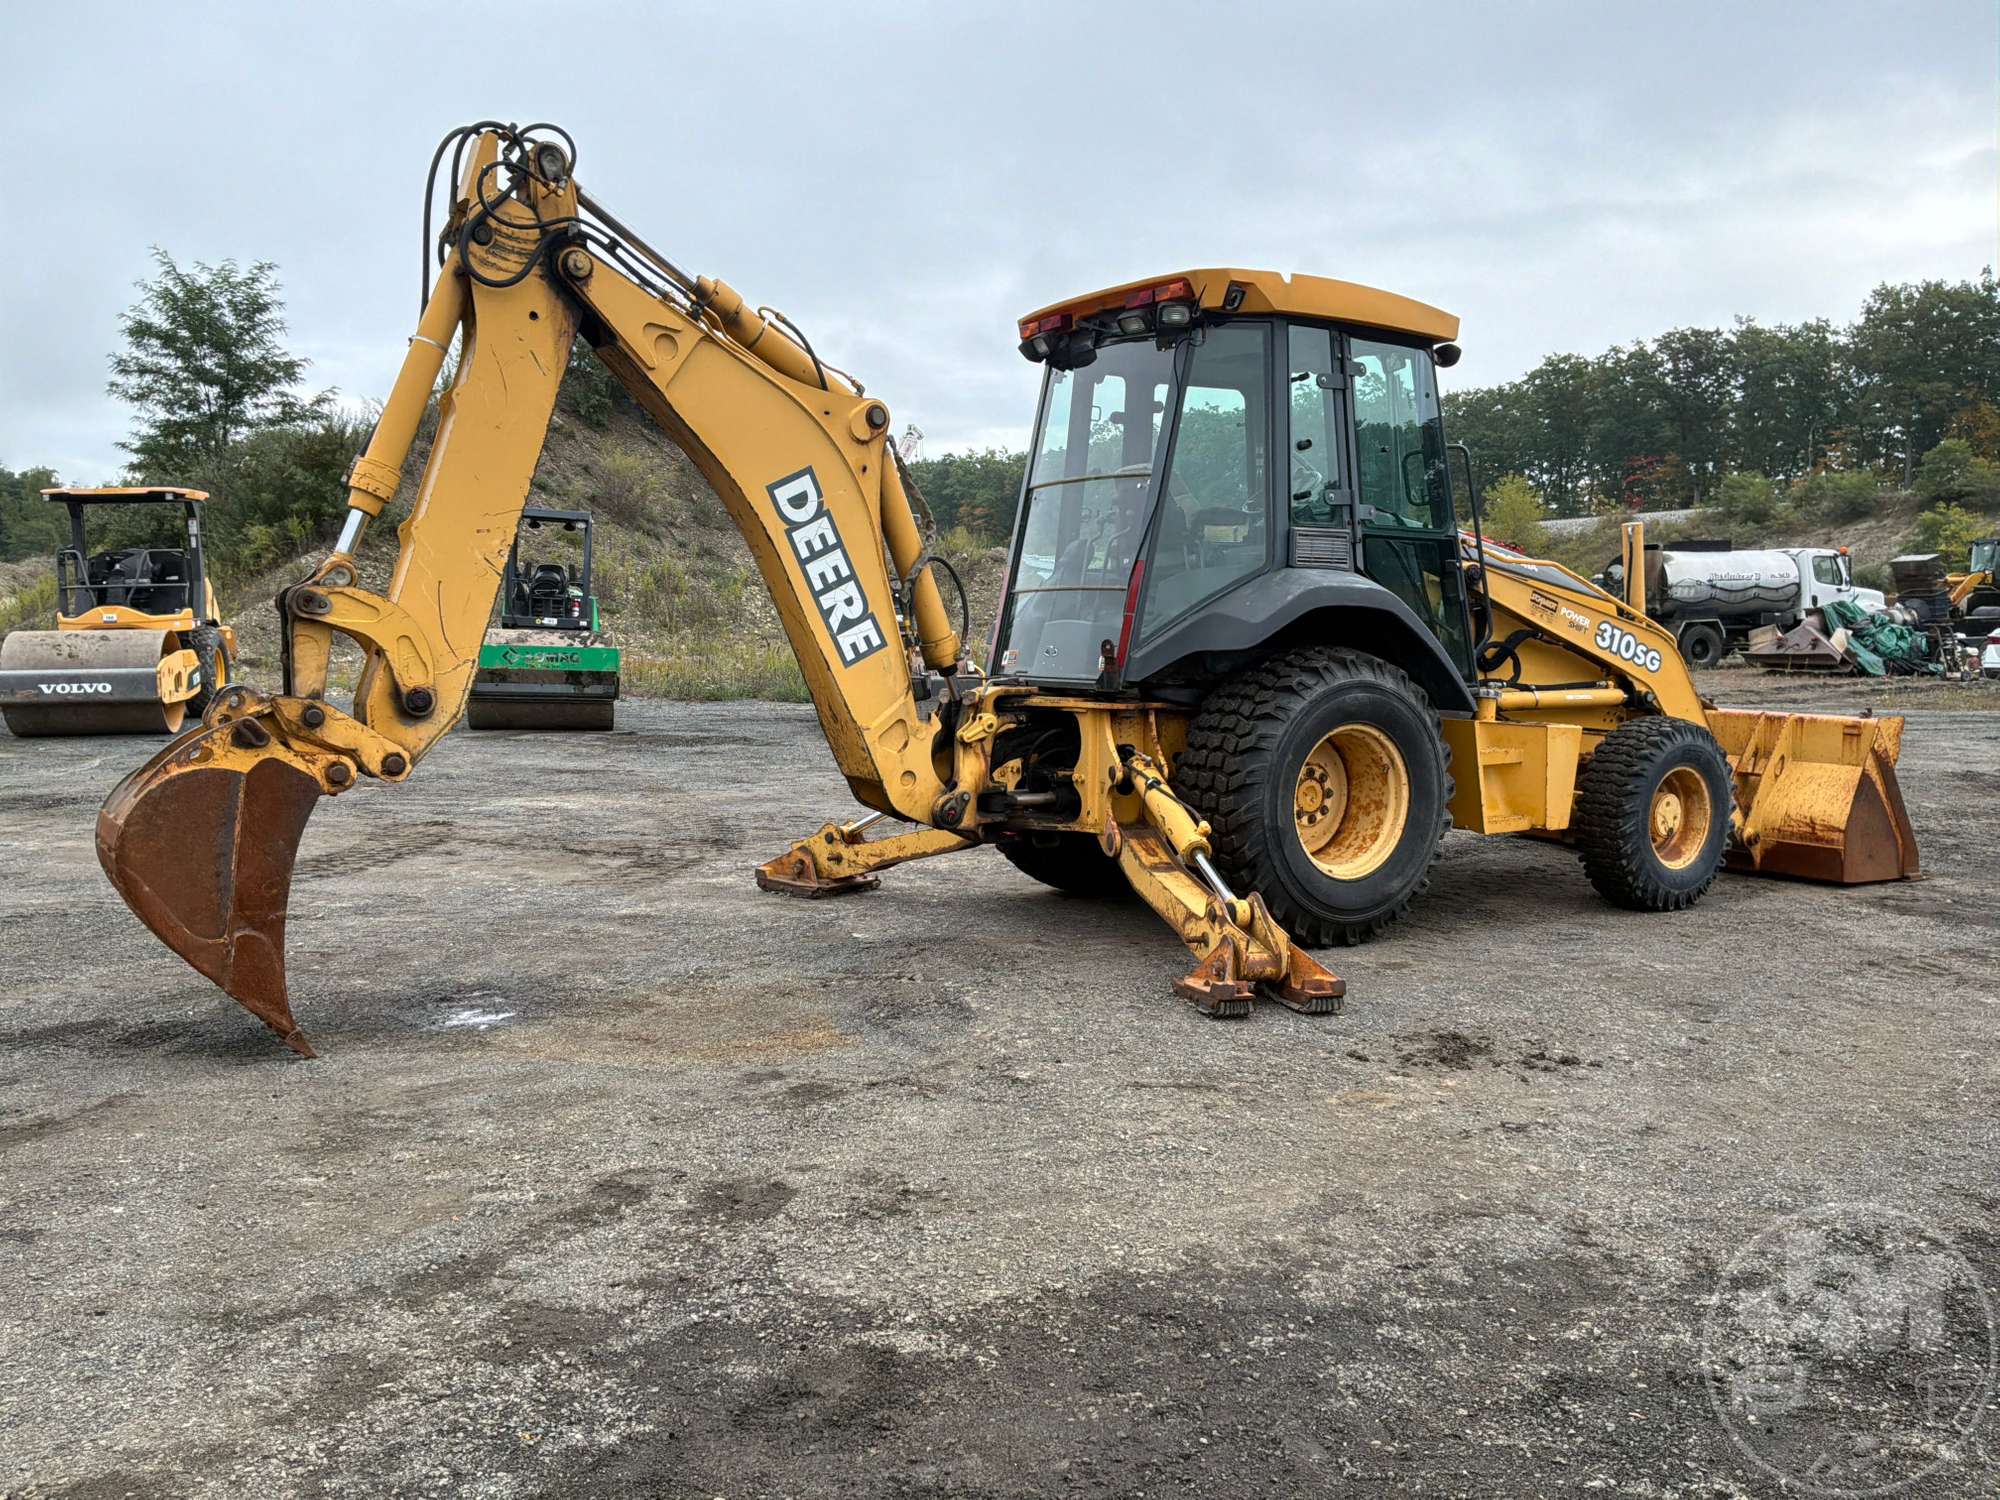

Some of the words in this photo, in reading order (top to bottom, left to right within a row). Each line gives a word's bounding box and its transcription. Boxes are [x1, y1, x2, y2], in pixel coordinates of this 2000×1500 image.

[773, 472, 882, 663] DEERE
[1560, 607, 1591, 626] POWER
[1595, 620, 1661, 673] 310SG
[37, 683, 113, 694] VOLVO
